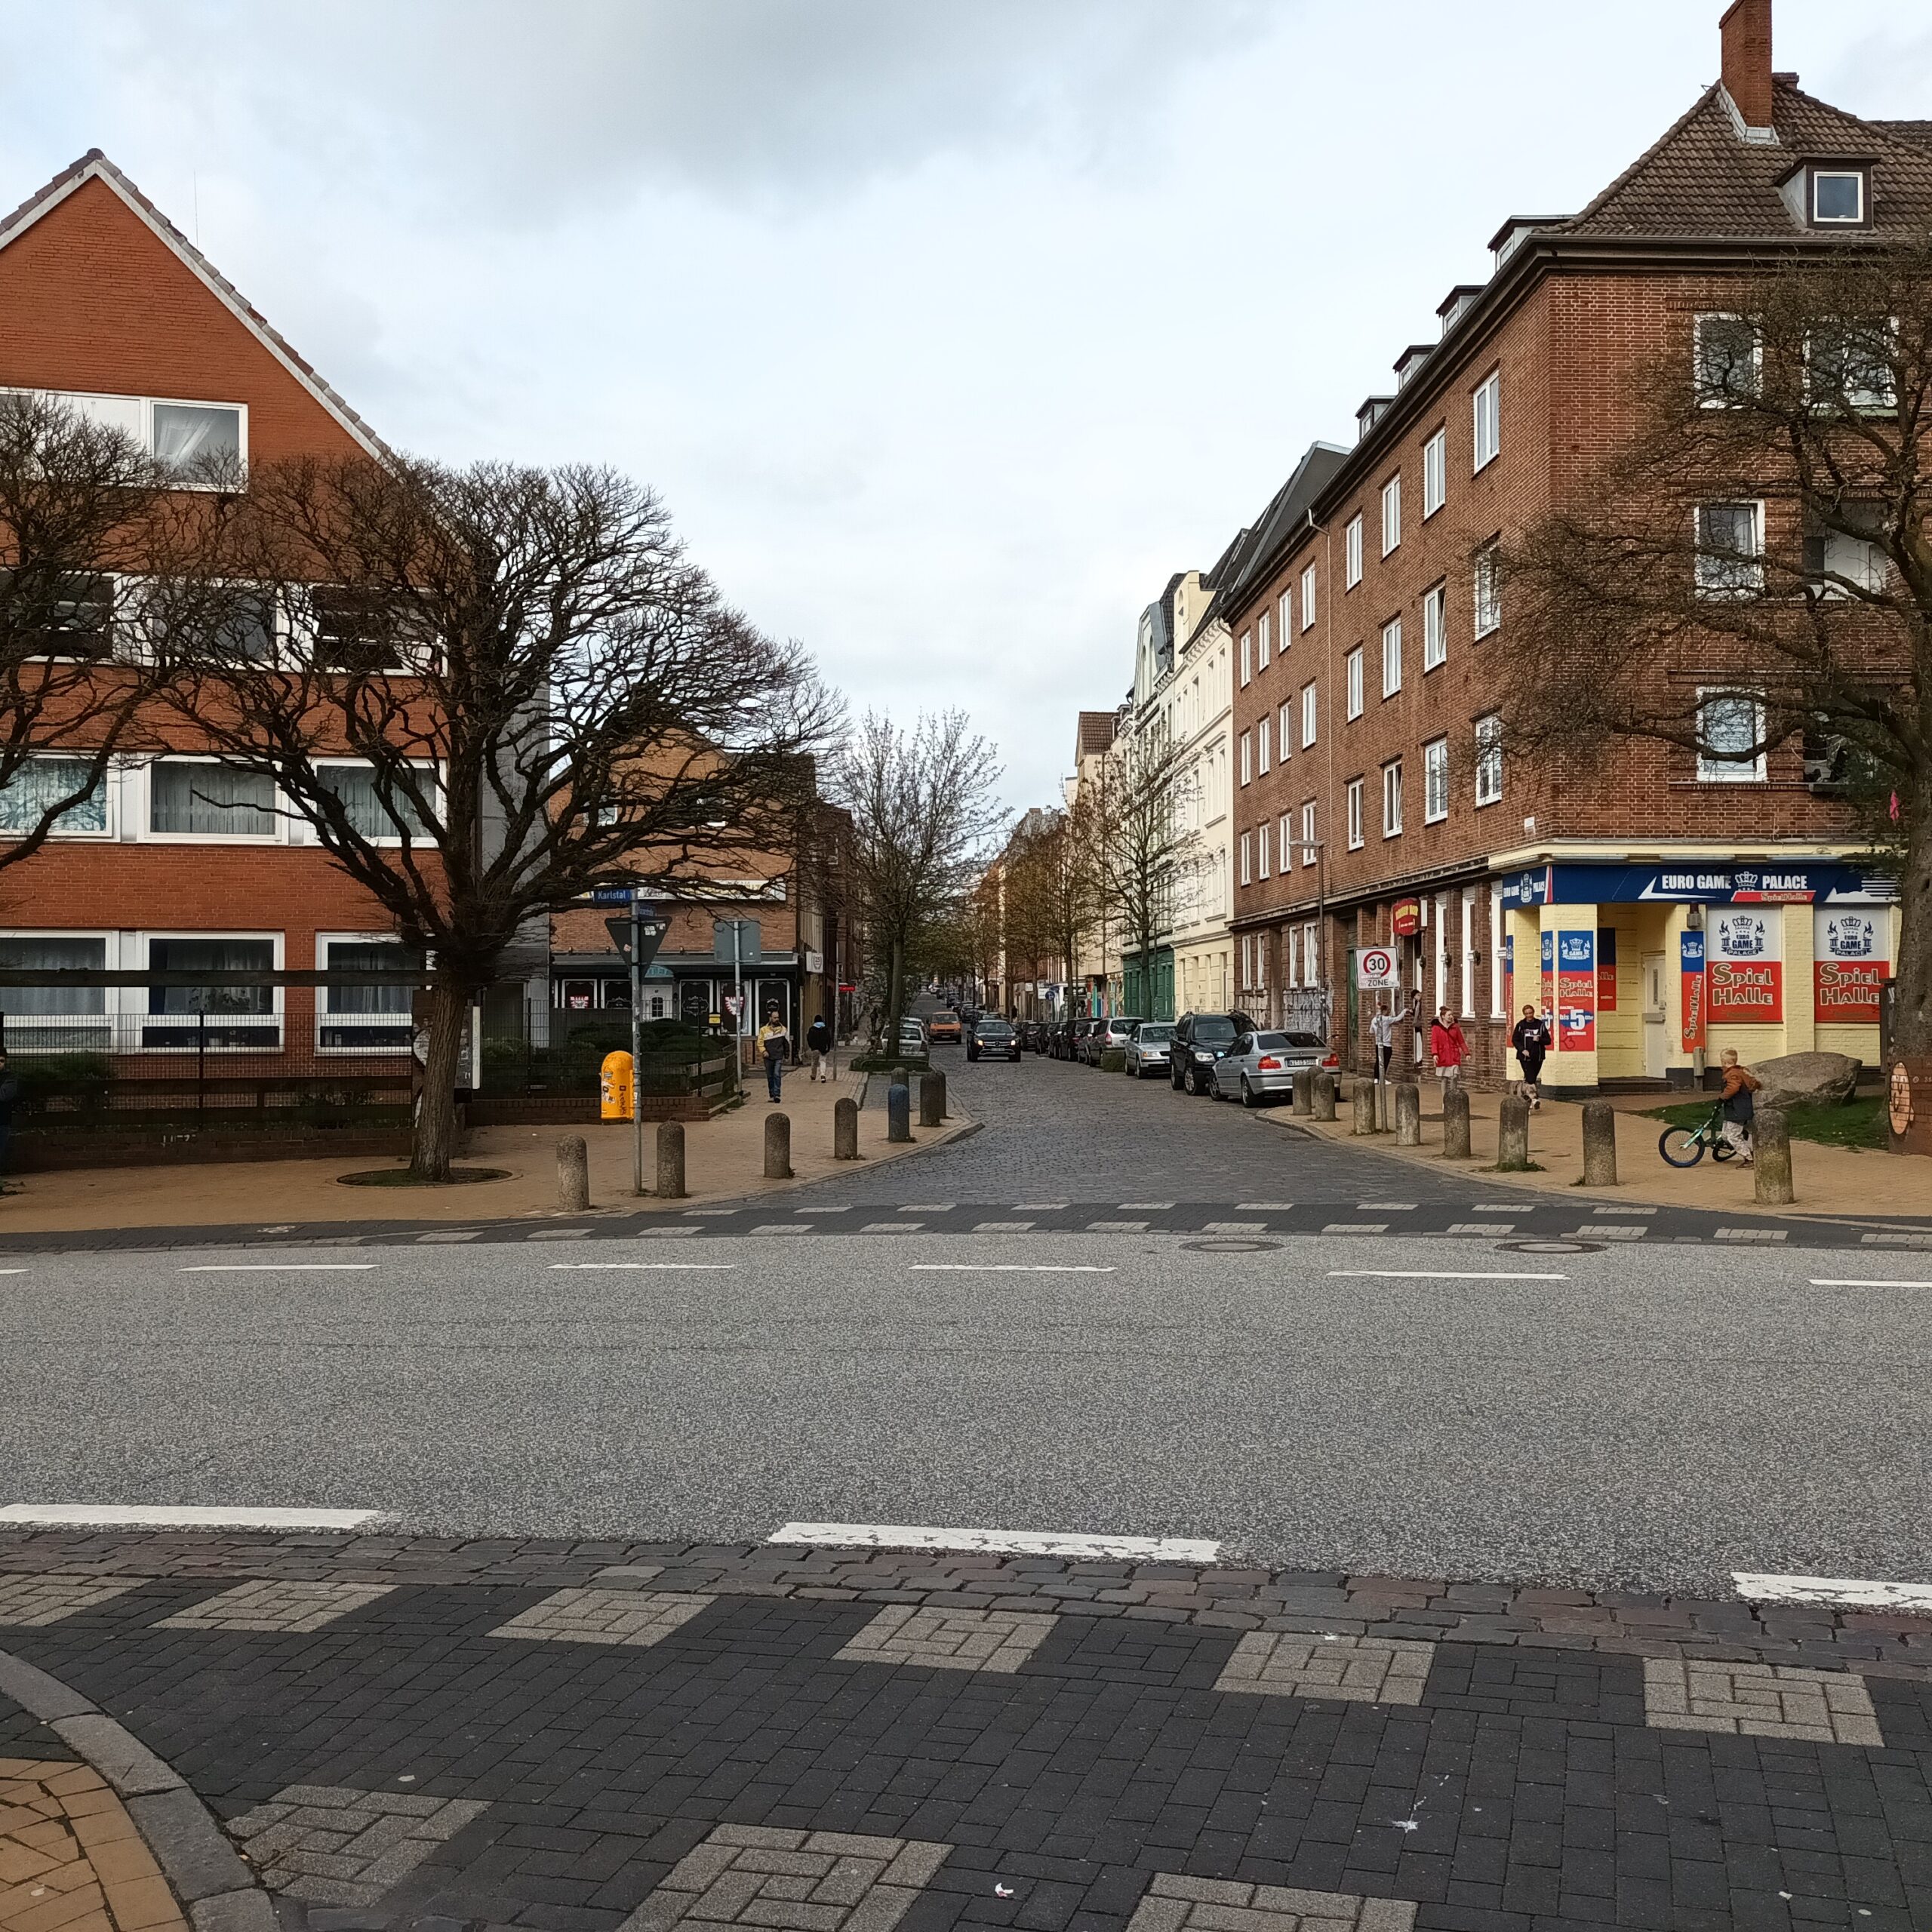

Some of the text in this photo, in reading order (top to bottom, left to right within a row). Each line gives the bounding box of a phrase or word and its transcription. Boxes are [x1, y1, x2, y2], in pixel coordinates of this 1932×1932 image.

[1662, 875, 1807, 889] EURO GAME PALACE
[598, 891, 626, 900] Karlstal
[1732, 940, 1753, 949] GAME
[1840, 940, 1862, 949] GAME
[1369, 958, 1386, 971] 30
[1712, 962, 1774, 988] Spiel
[1819, 962, 1881, 988] Spiel
[1367, 979, 1389, 987] ZONE
[1559, 977, 1593, 989] Spiel
[1712, 986, 1774, 1007] Halle
[1820, 986, 1880, 1006] Halle
[1570, 1008, 1585, 1030] 5
